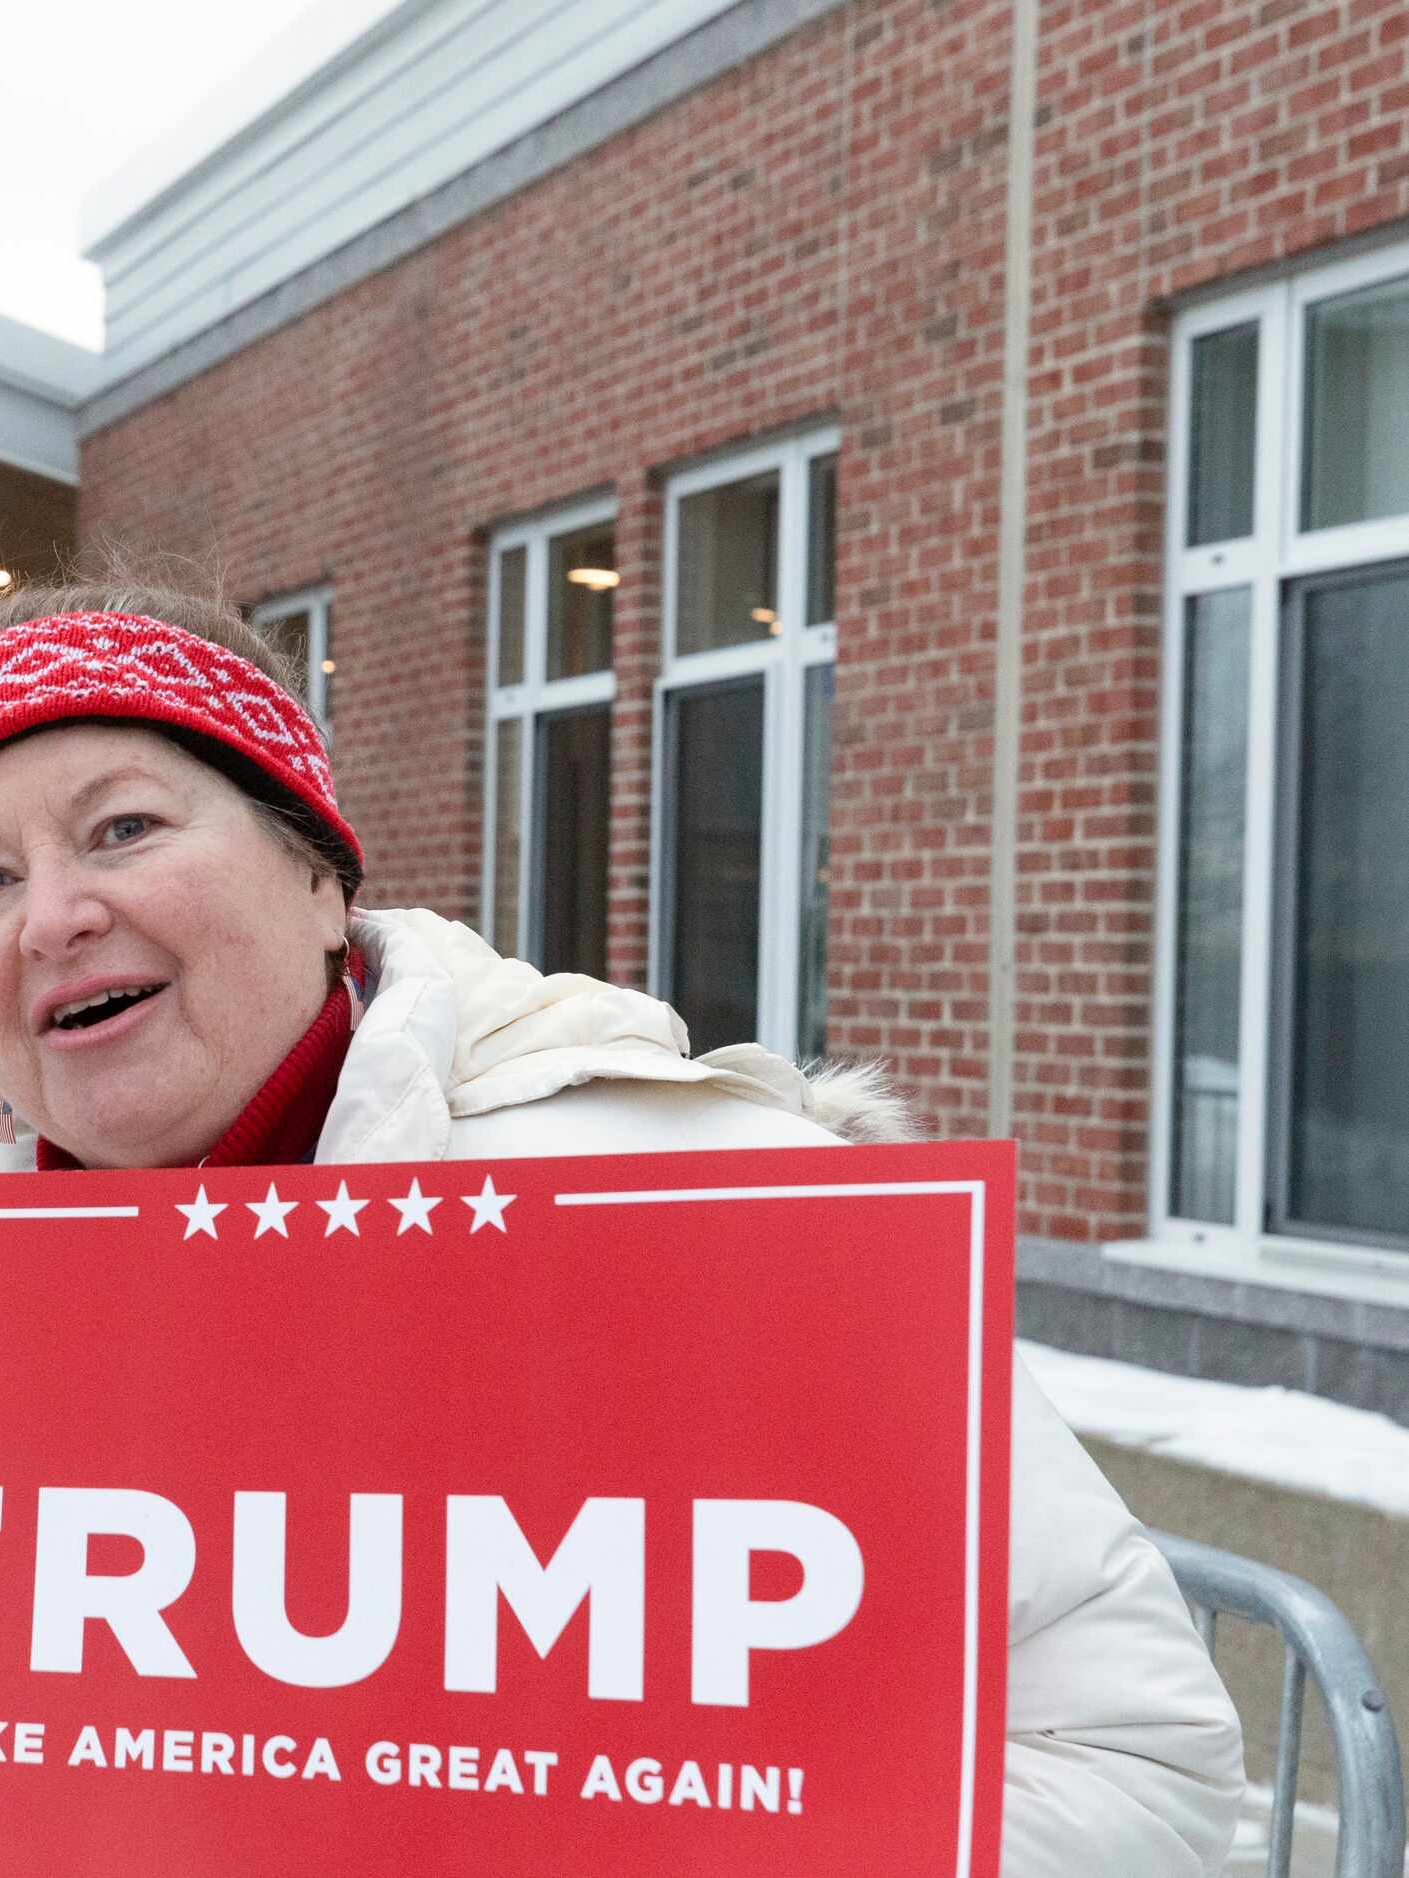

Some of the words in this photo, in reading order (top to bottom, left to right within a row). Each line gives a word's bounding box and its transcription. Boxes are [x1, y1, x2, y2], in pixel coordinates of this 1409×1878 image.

[68, 1726, 341, 1780] AMERICA
[366, 1741, 558, 1795] GREAT
[581, 1755, 803, 1814] AGAIN!
